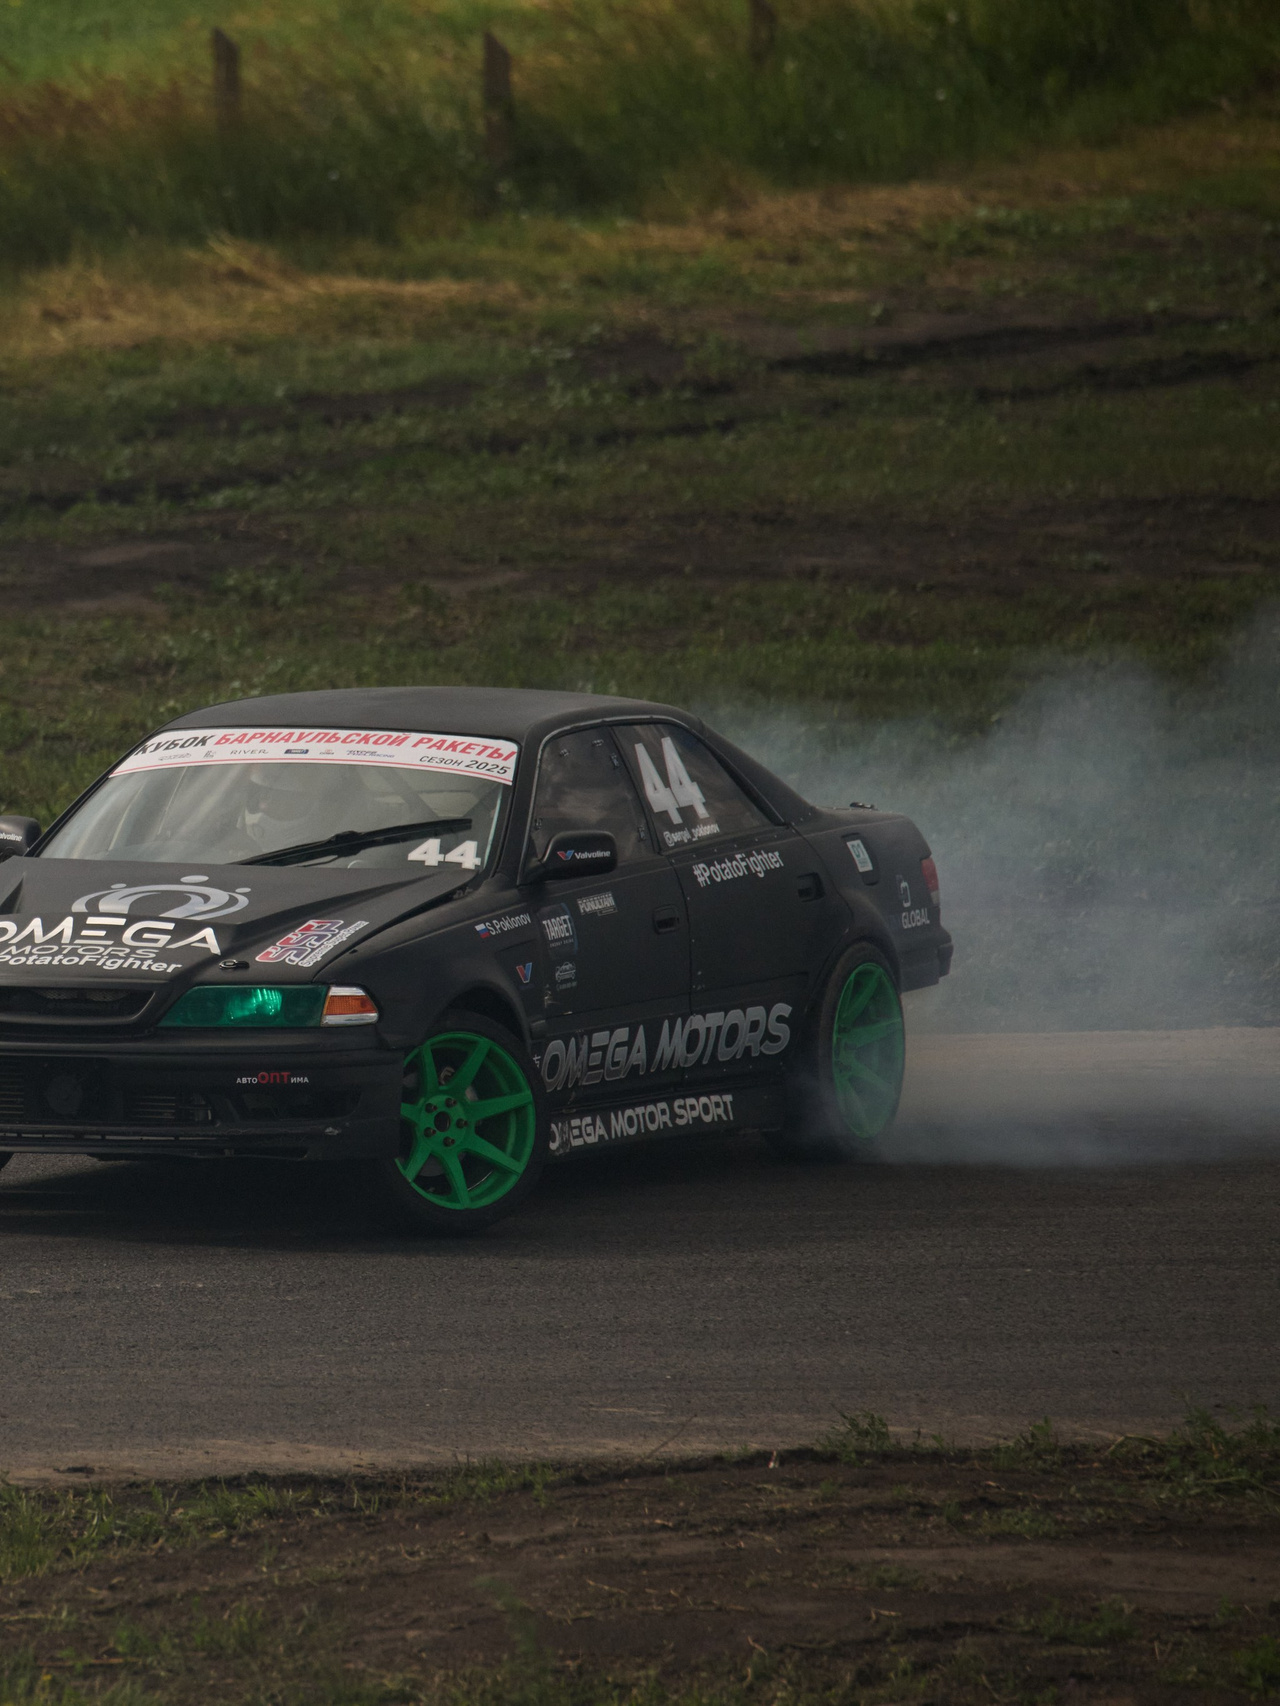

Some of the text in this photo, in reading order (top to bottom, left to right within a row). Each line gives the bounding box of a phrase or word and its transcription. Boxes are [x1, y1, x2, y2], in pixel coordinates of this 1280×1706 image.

[134, 731, 517, 762] КУБОК БАРНАУЛЬСКОЙ РАКЕТЫ
[419, 755, 512, 775] СЕЗОН 2025
[634, 736, 710, 825] 44
[407, 838, 482, 870] 44
[574, 850, 611, 860] Valvoline
[692, 849, 784, 887] #PotatoFighter
[542, 914, 573, 941] TARGET
[901, 908, 930, 930] GLOBAL
[0, 944, 158, 960] MOTORS
[540, 1003, 793, 1093] OMEGA MOTORS
[610, 1101, 673, 1140] MOTOR
[674, 1094, 734, 1126] SPORT
